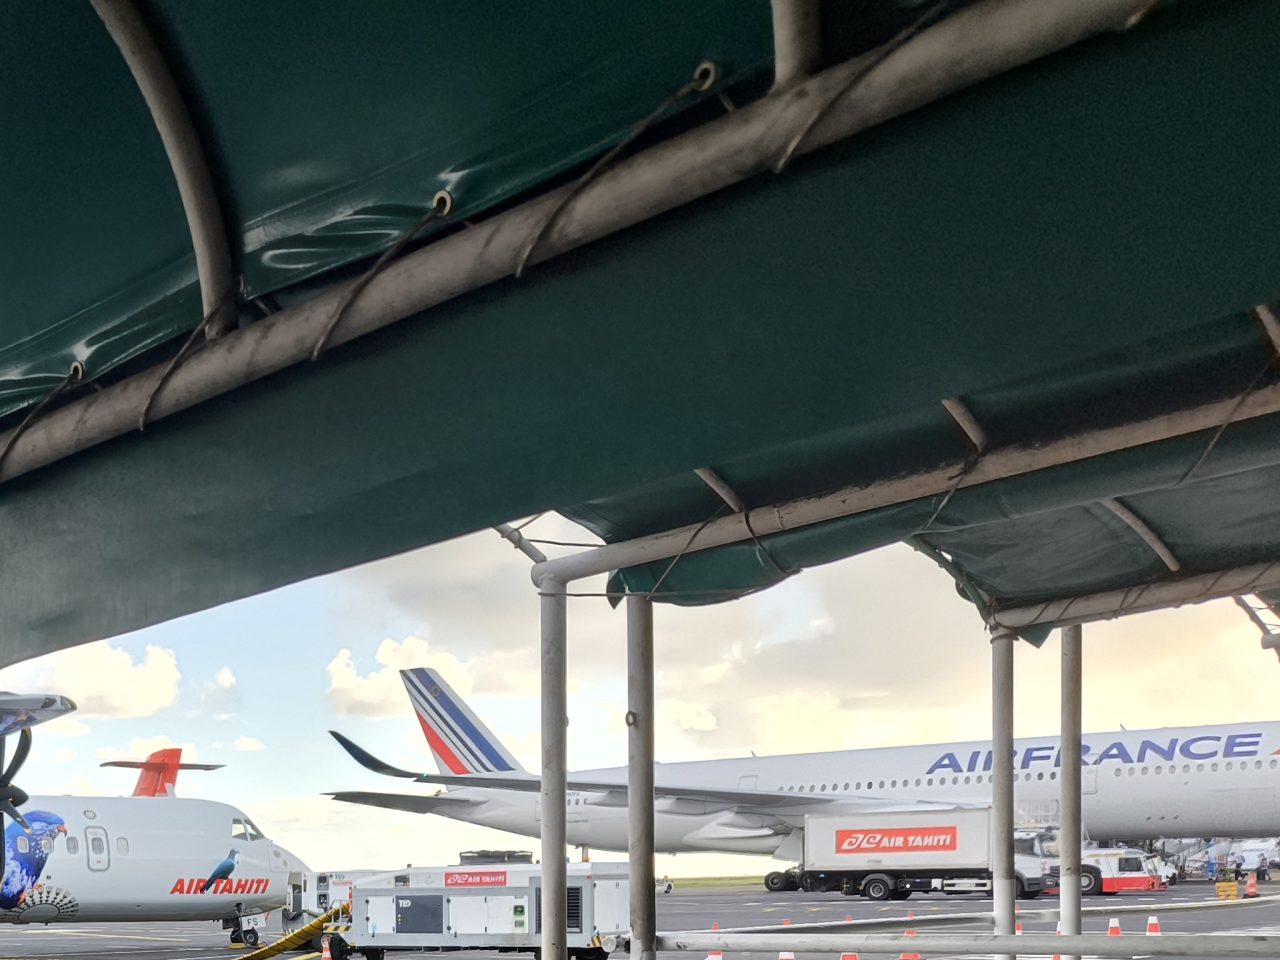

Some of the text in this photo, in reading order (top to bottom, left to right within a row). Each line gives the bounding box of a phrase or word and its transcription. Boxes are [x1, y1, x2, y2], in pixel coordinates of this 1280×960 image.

[879, 834, 951, 848] AIR TAHITI
[169, 878, 270, 895] AIR TAHITI
